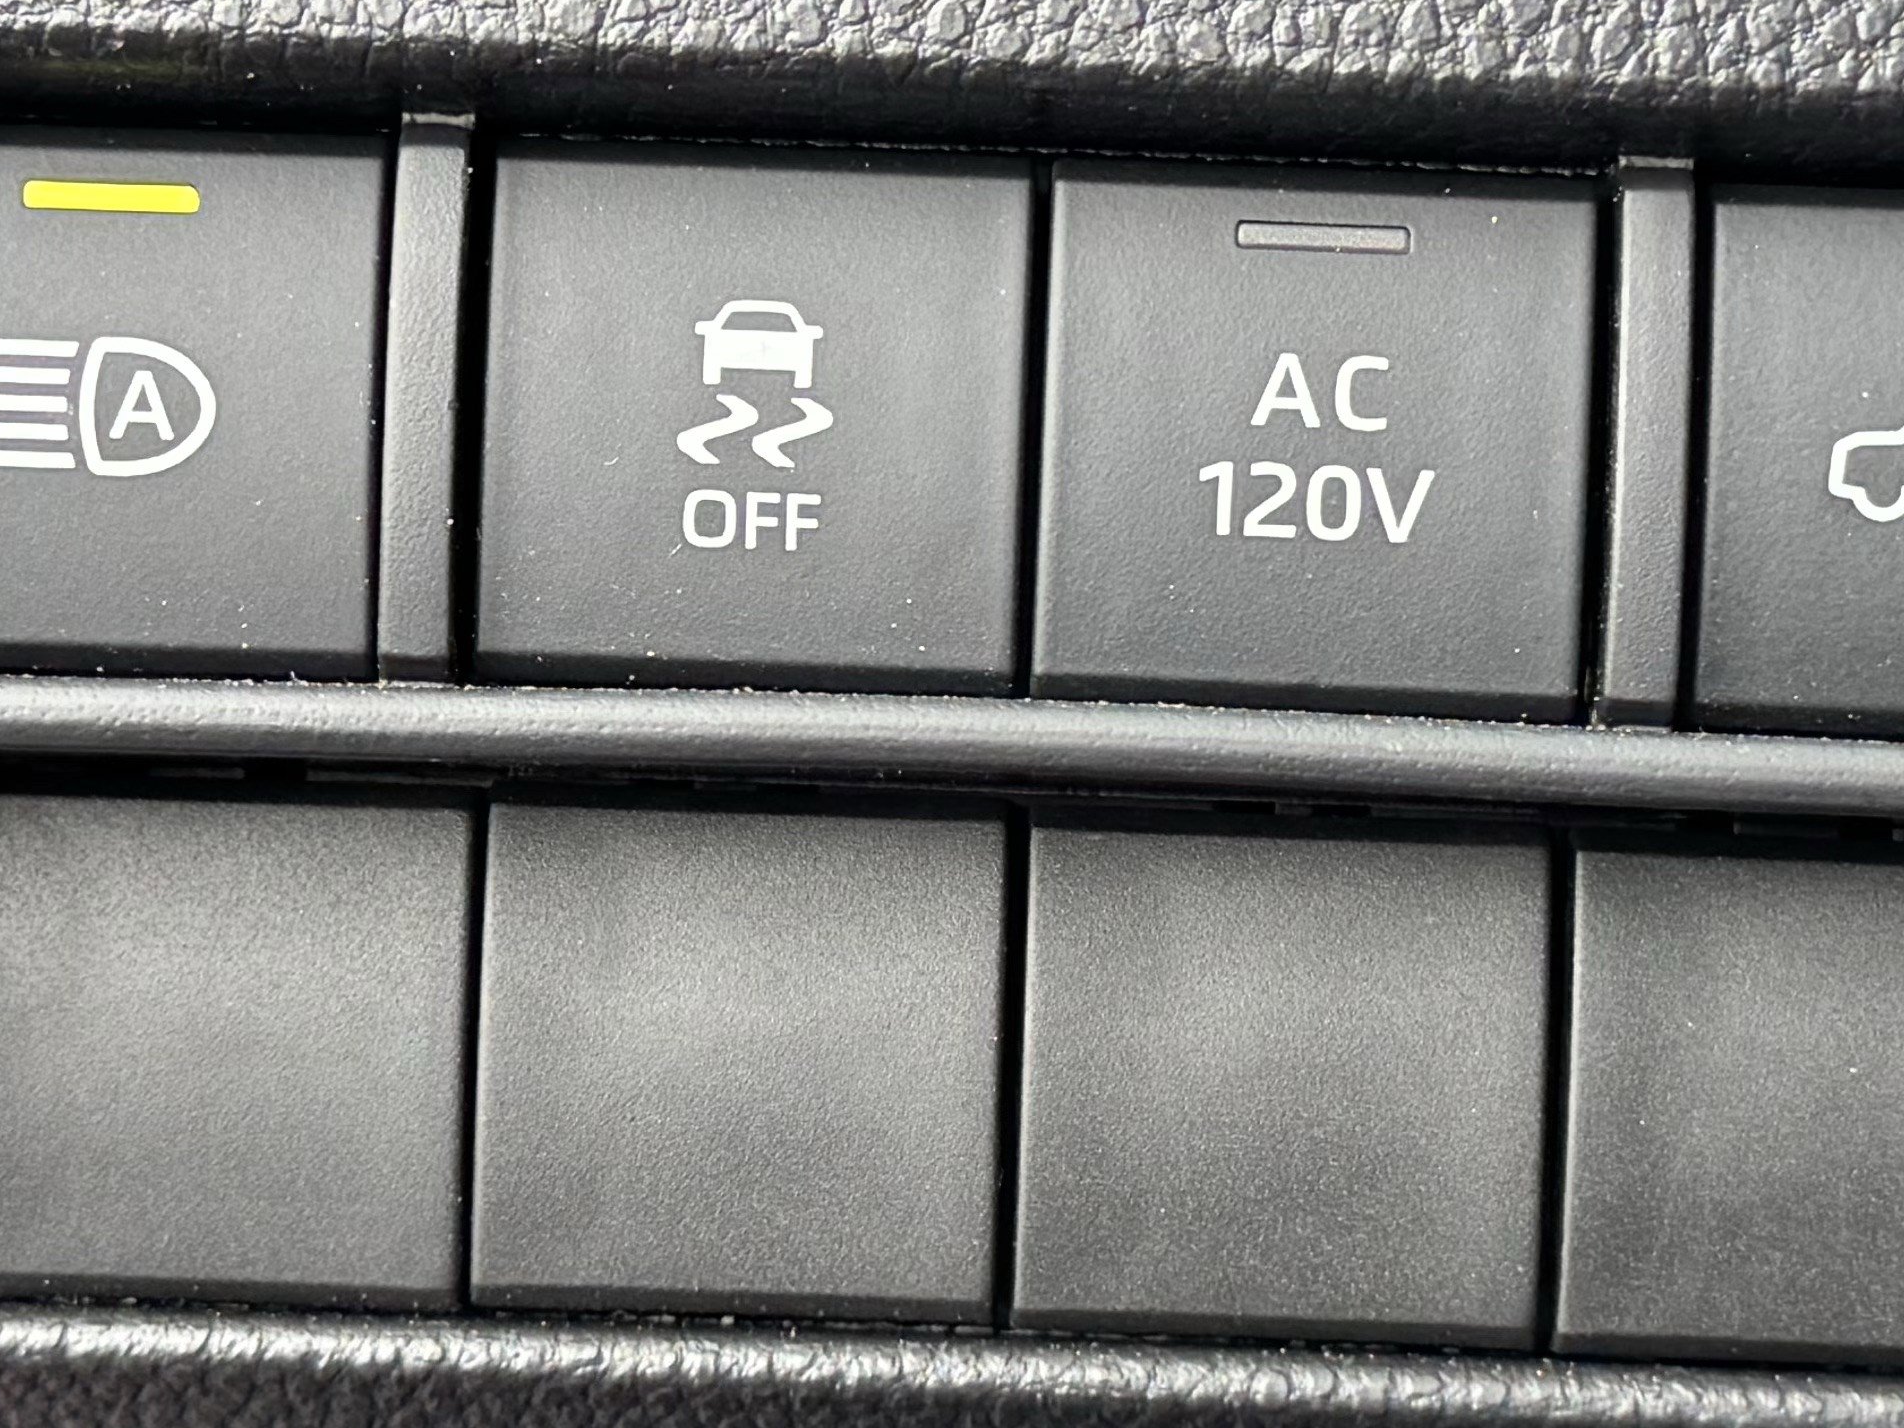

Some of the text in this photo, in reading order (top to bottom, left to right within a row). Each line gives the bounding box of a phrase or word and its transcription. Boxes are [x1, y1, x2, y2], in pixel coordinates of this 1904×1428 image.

[110, 369, 175, 440] A
[1251, 353, 1390, 432] AC
[683, 489, 822, 551] OFF
[1198, 460, 1435, 544] 120V
